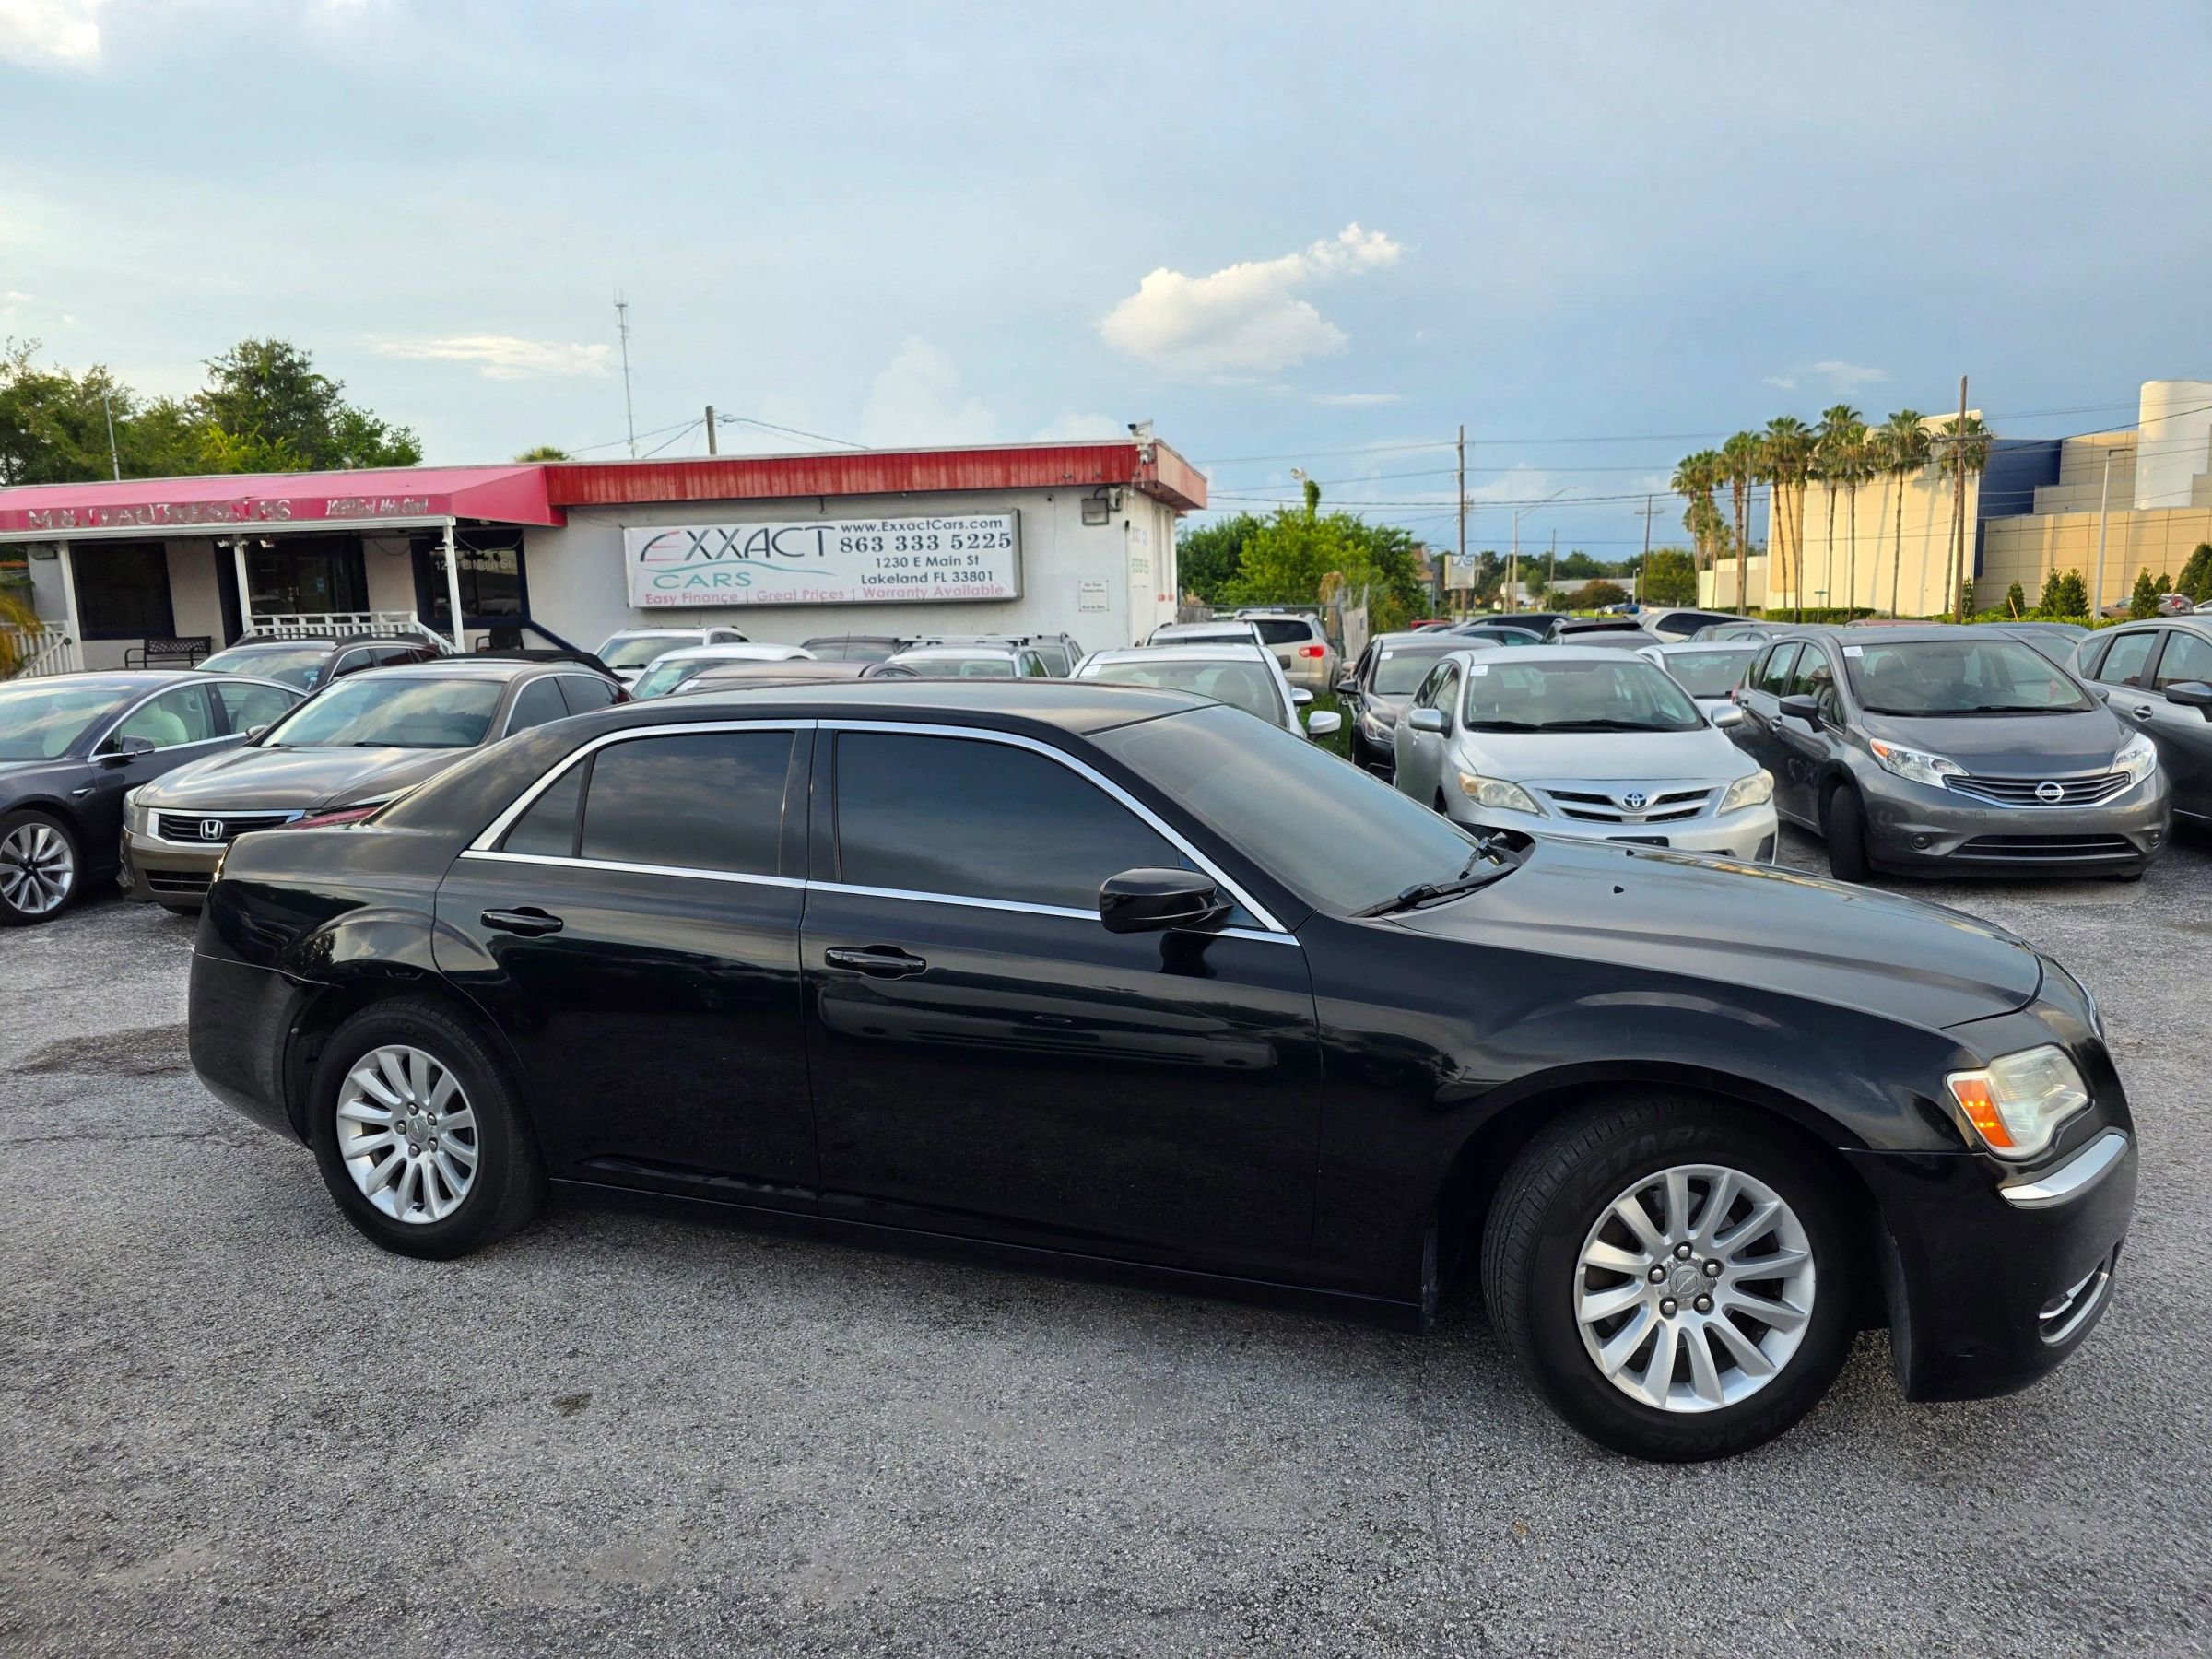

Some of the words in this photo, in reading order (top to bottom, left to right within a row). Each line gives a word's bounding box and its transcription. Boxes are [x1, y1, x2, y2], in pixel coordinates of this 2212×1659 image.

[841, 518, 1003, 533] www.ExxactCars.com
[640, 525, 835, 562] EXXACT
[839, 535, 884, 553] 863
[895, 535, 940, 552] 333
[950, 533, 1012, 550] 5225
[876, 556, 909, 568] 1230
[913, 557, 921, 567] E
[925, 555, 961, 567] Main
[967, 554, 979, 566] St
[653, 572, 752, 589] CARS
[861, 572, 928, 585] Lakeland
[934, 572, 947, 583] FL
[952, 571, 993, 583] 33801
[645, 593, 677, 606] Easy
[682, 592, 738, 605] Finance
[758, 590, 797, 602] Great
[802, 588, 844, 602] Prices
[863, 586, 927, 600] Warranty
[934, 584, 1004, 597] Available
